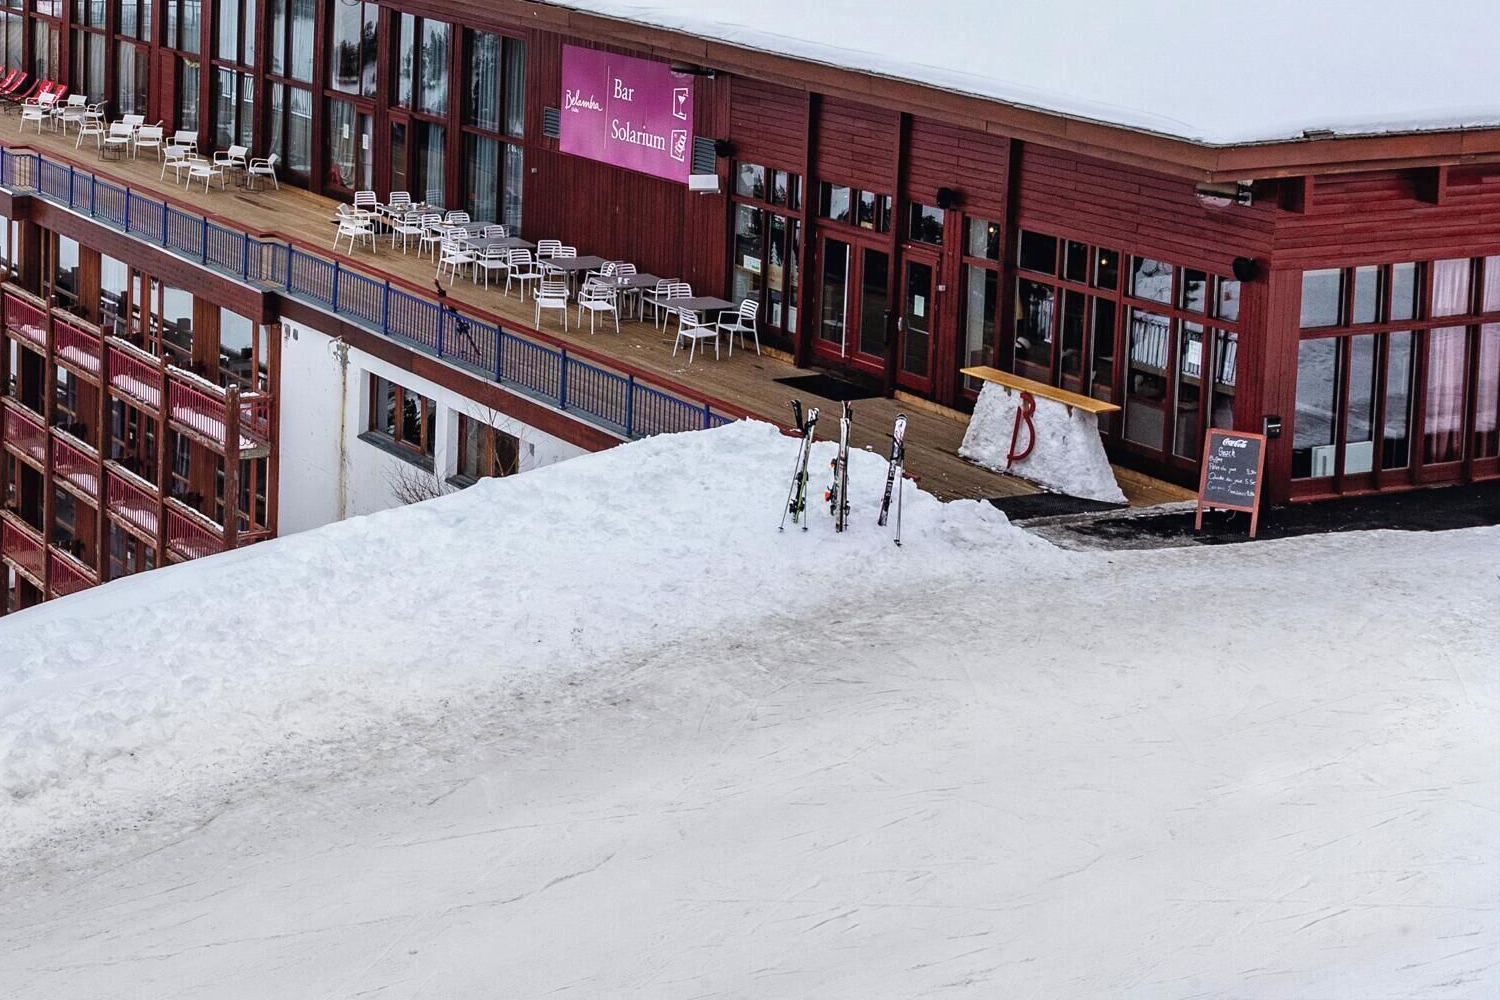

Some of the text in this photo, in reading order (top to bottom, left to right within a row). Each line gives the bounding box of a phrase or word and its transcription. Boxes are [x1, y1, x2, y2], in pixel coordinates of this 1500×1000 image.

[565, 89, 603, 112] Belambra
[613, 78, 635, 102] Bar
[611, 119, 666, 151] Solarium
